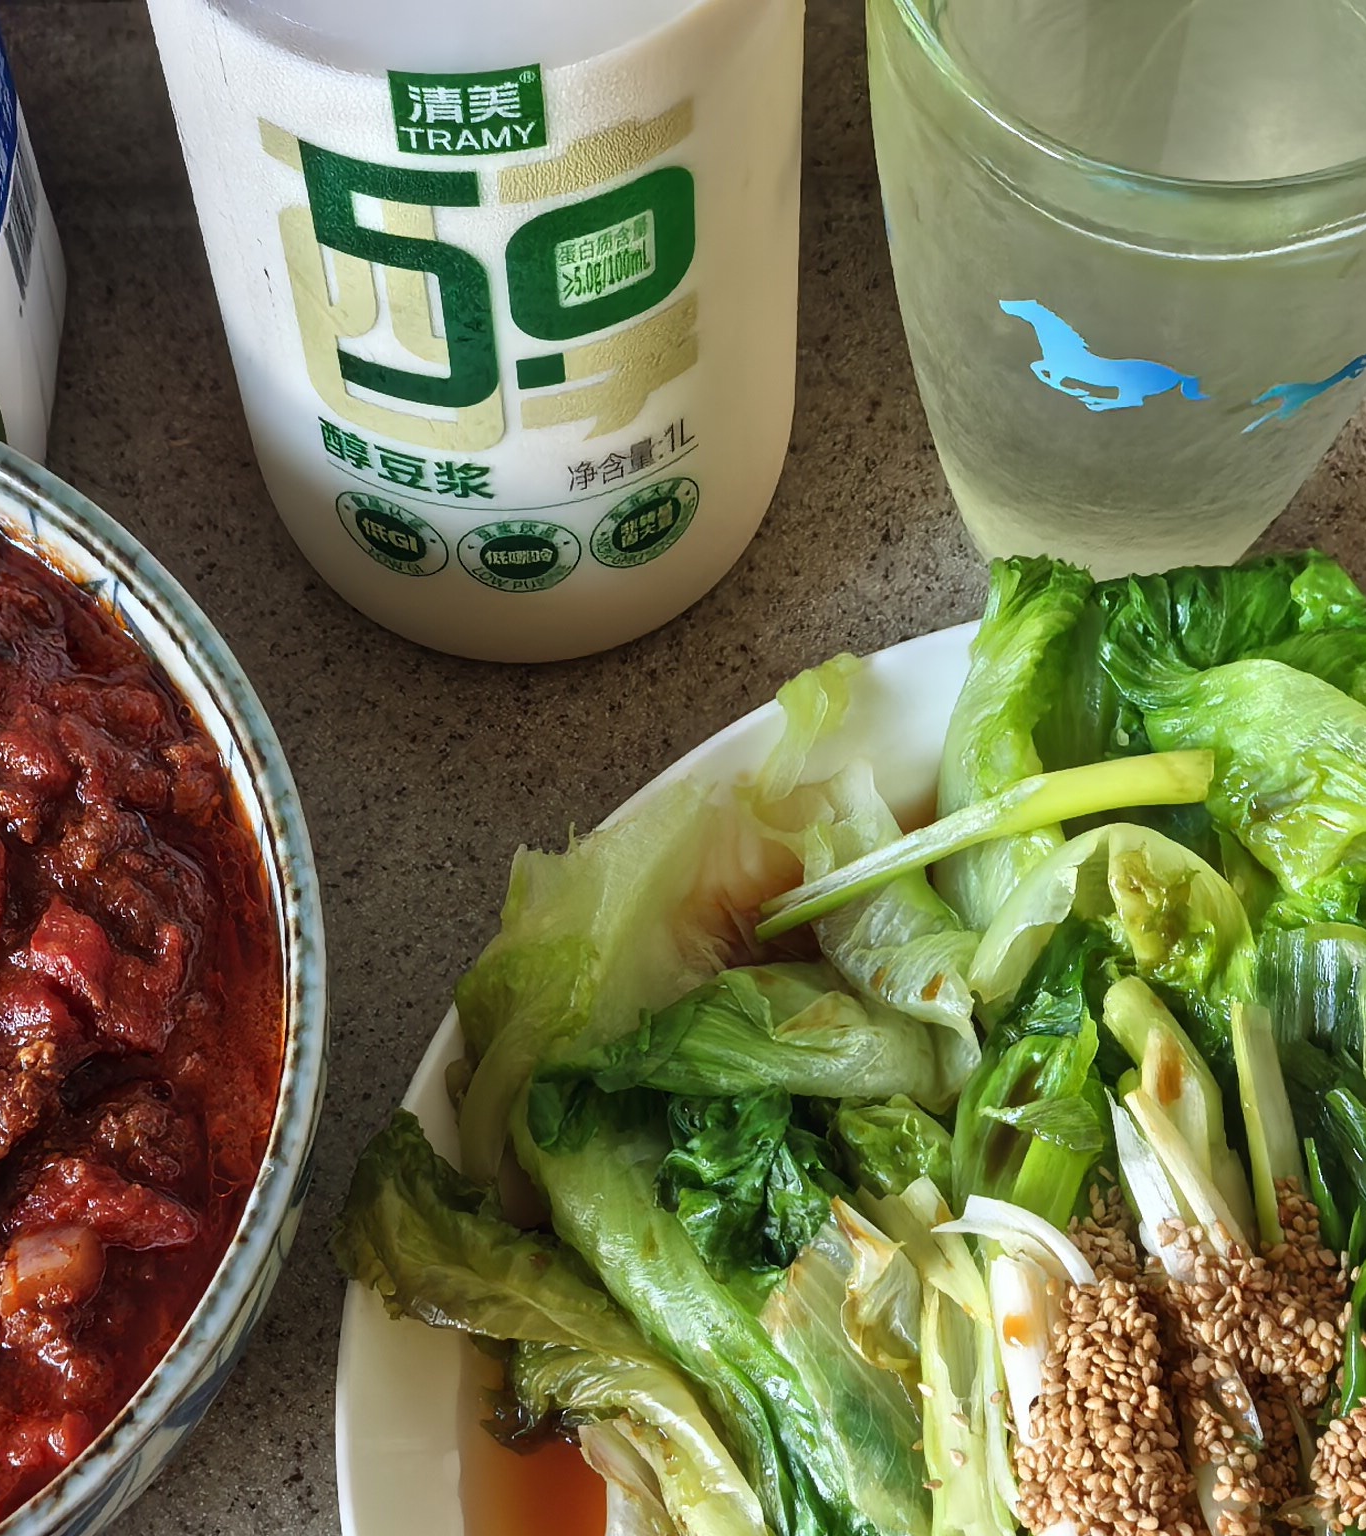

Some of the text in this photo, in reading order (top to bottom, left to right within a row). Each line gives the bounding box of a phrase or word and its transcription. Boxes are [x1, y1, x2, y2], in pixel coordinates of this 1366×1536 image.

[407, 81, 523, 124] 清美
[398, 121, 536, 151] TRAMY
[298, 138, 696, 407] 5.0
[318, 416, 495, 500] 醇豆浆
[361, 517, 419, 553] 低GI
